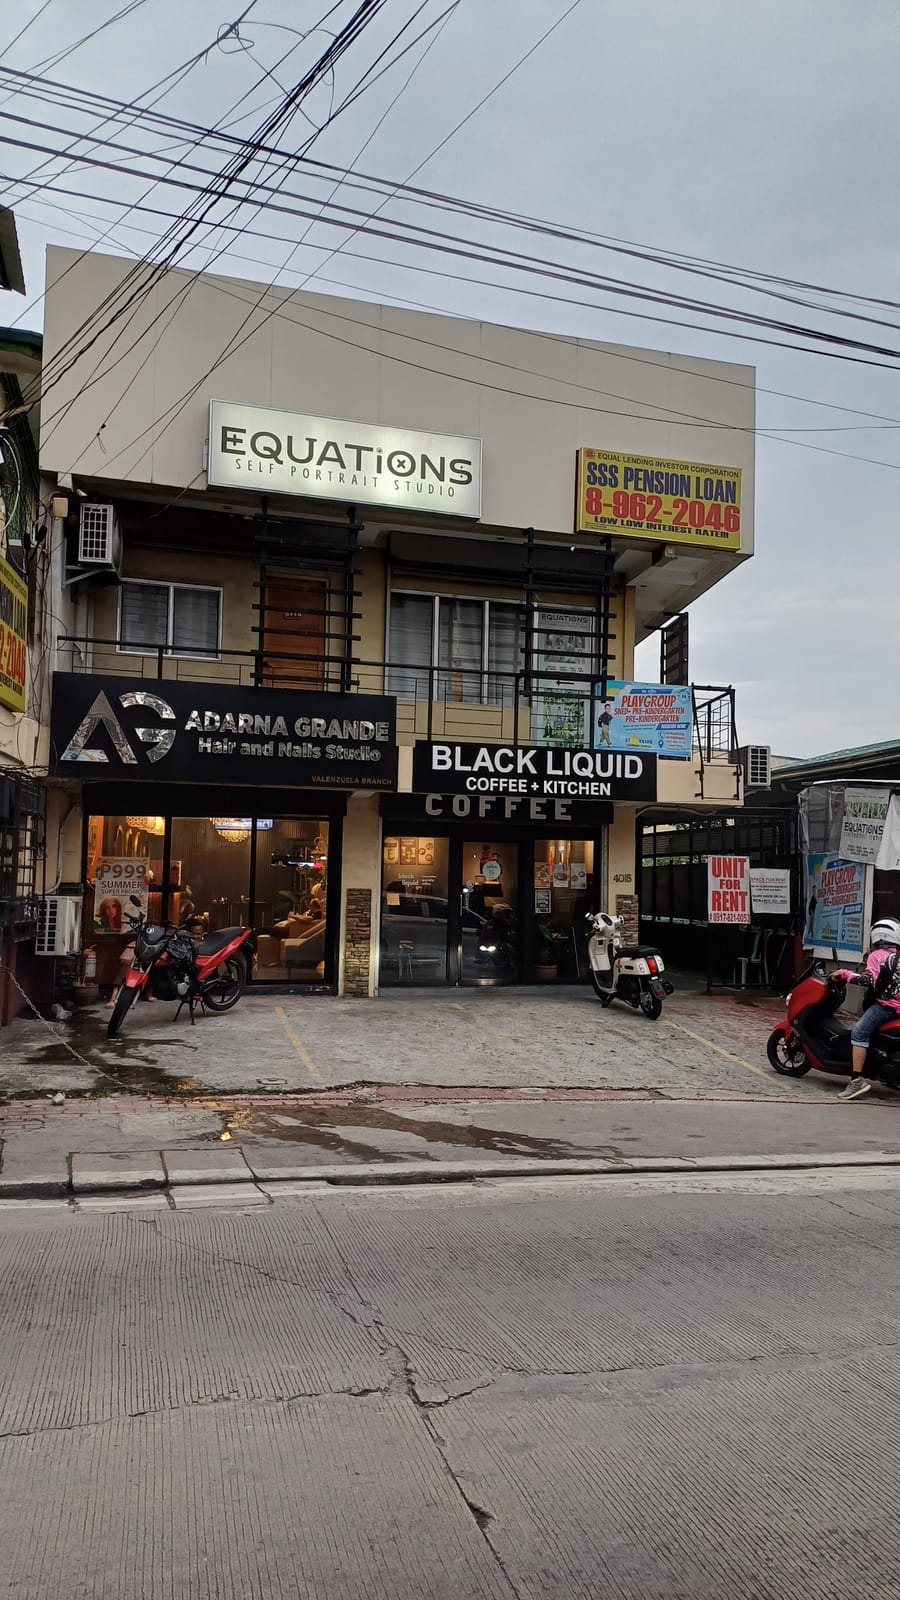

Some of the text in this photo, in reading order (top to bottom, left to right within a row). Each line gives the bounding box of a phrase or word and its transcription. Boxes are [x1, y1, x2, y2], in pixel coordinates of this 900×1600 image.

[597, 452, 739, 478] EQUAL LENDING INVESTOR CORPORATION
[235, 458, 456, 498] SELF PORTRAIT STUDIO
[586, 461, 737, 504] SSS PENSION LOAN
[585, 486, 741, 533] 8-962-2046
[594, 516, 618, 526] LOW
[620, 518, 644, 529] LOW
[646, 522, 692, 535] INTEREST
[621, 694, 677, 708] PLAYGROUP
[184, 709, 390, 742] ADARNA GRANDE
[198, 737, 382, 762] Hair and Nails Studio
[431, 745, 644, 779] BLACK LIQUID
[311, 775, 393, 785] VALENZUELA BRANCH
[465, 776, 612, 797] COFFEE + KITCHEN
[425, 793, 573, 821] COFFEE
[101, 864, 147, 879] P999
[613, 873, 632, 883] 4015
[711, 857, 747, 879] UNIT
[821, 865, 857, 888] PLAYGROUP
[101, 880, 143, 889] SUMMER
[719, 879, 741, 890] FOR
[712, 890, 748, 912] RENT
